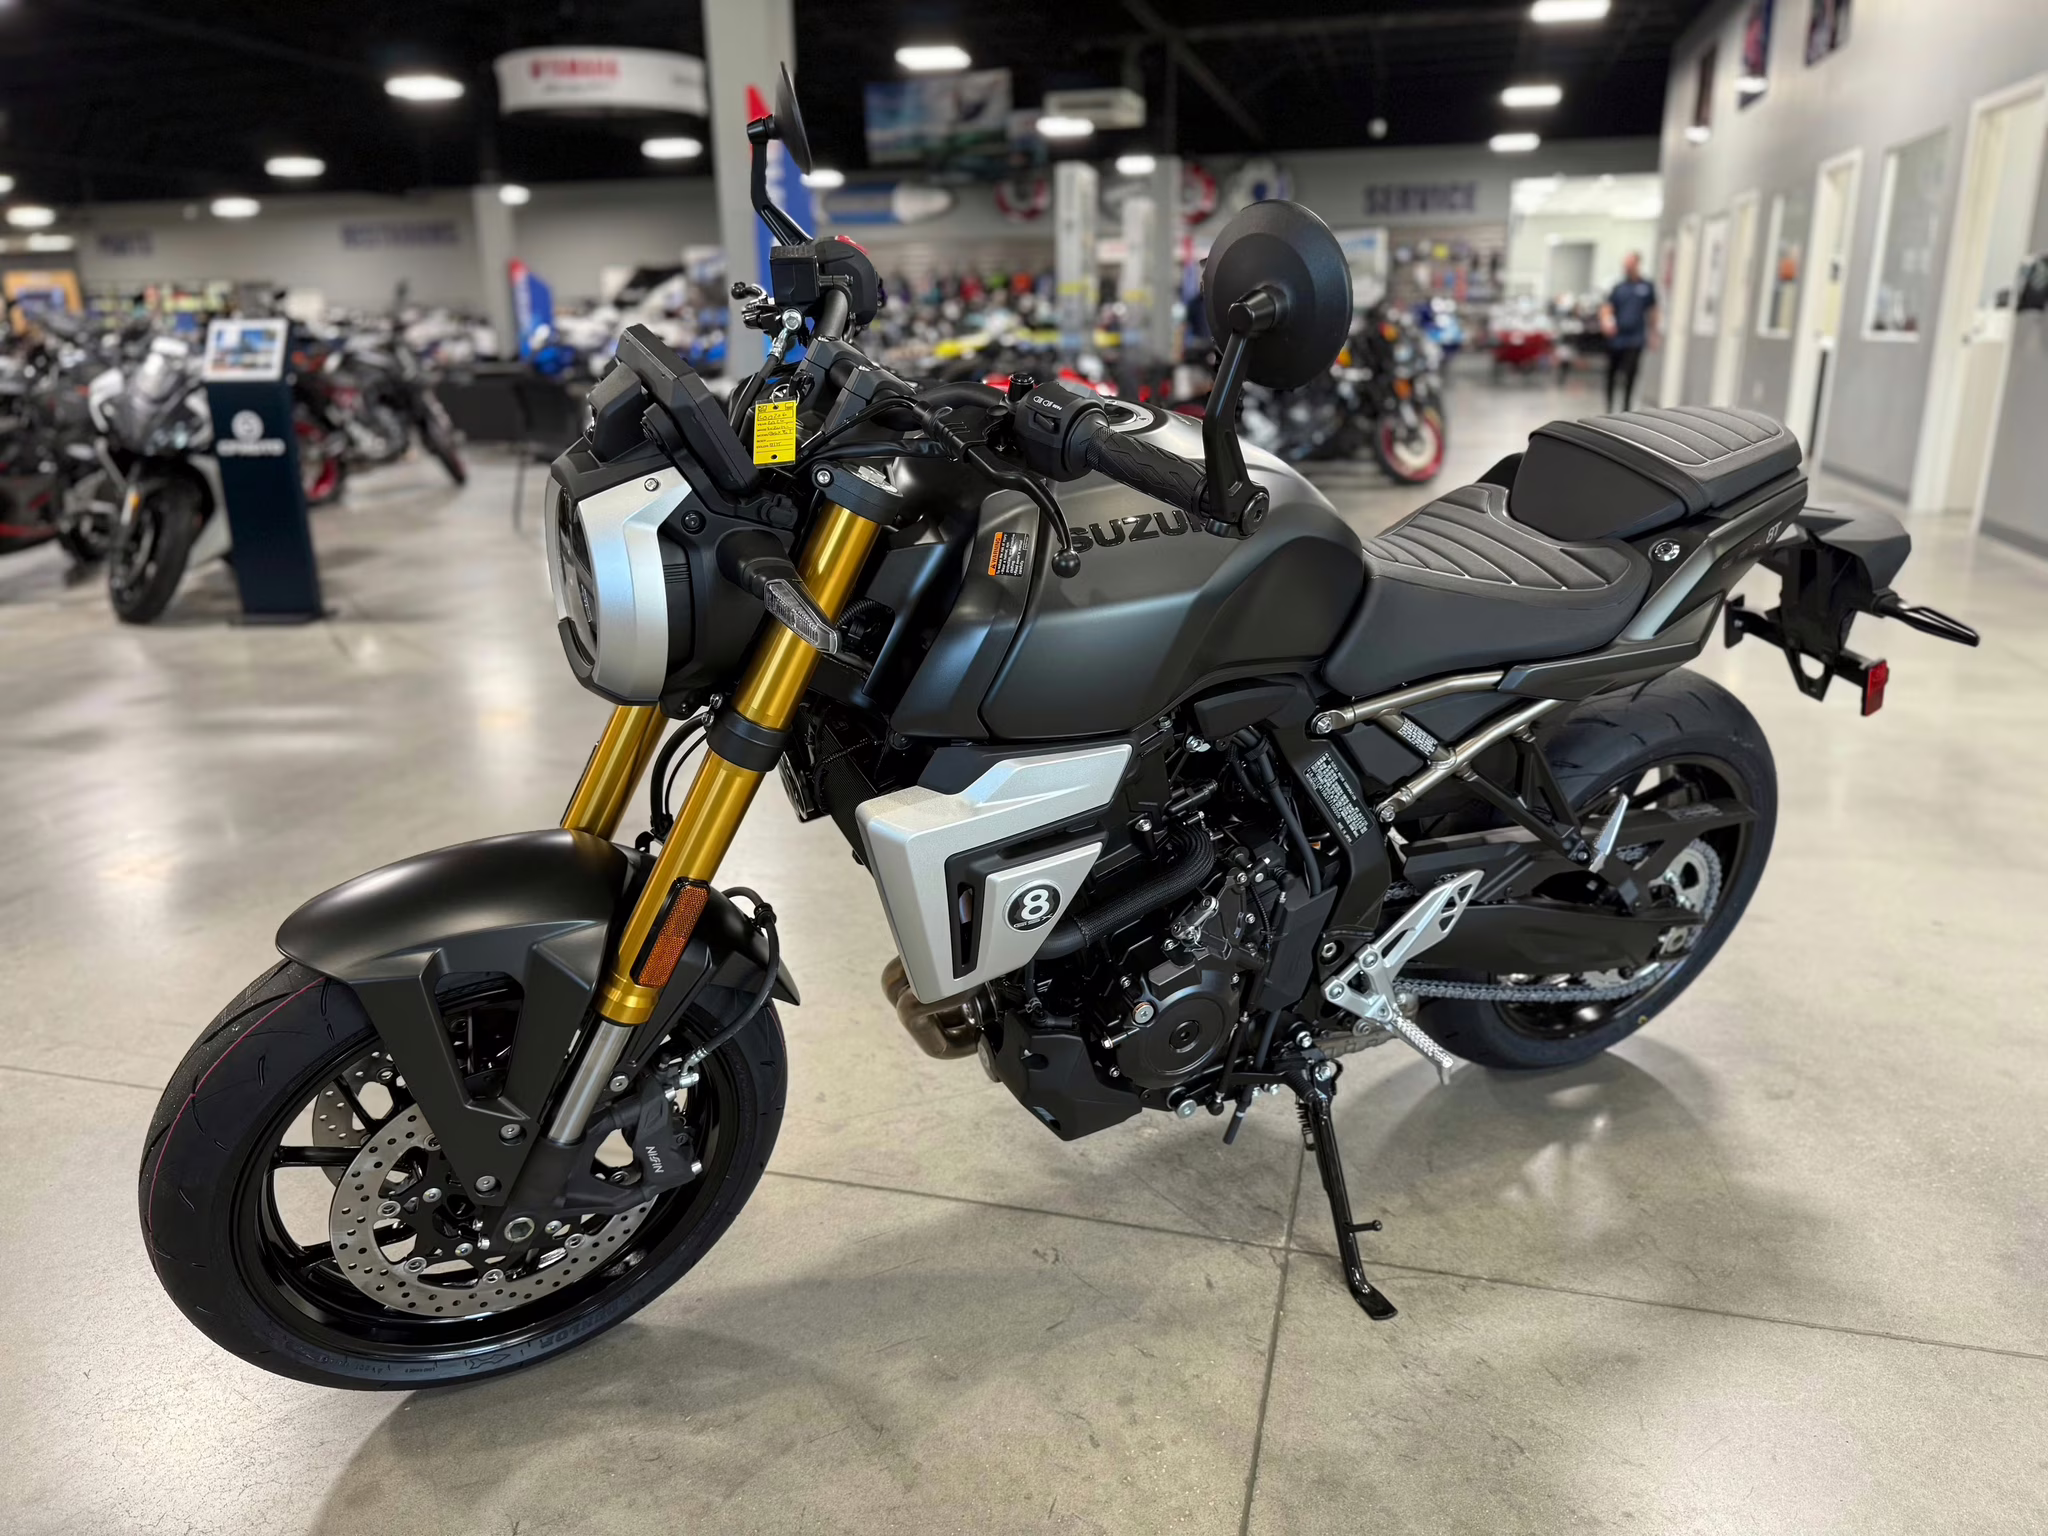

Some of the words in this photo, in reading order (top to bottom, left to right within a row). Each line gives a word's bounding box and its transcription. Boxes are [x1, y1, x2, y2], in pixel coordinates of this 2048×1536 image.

[1364, 182, 1476, 215] SERVICE
[1766, 521, 1782, 544] 8T
[992, 538, 1000, 563] WARNING
[1021, 889, 1050, 920] 8
